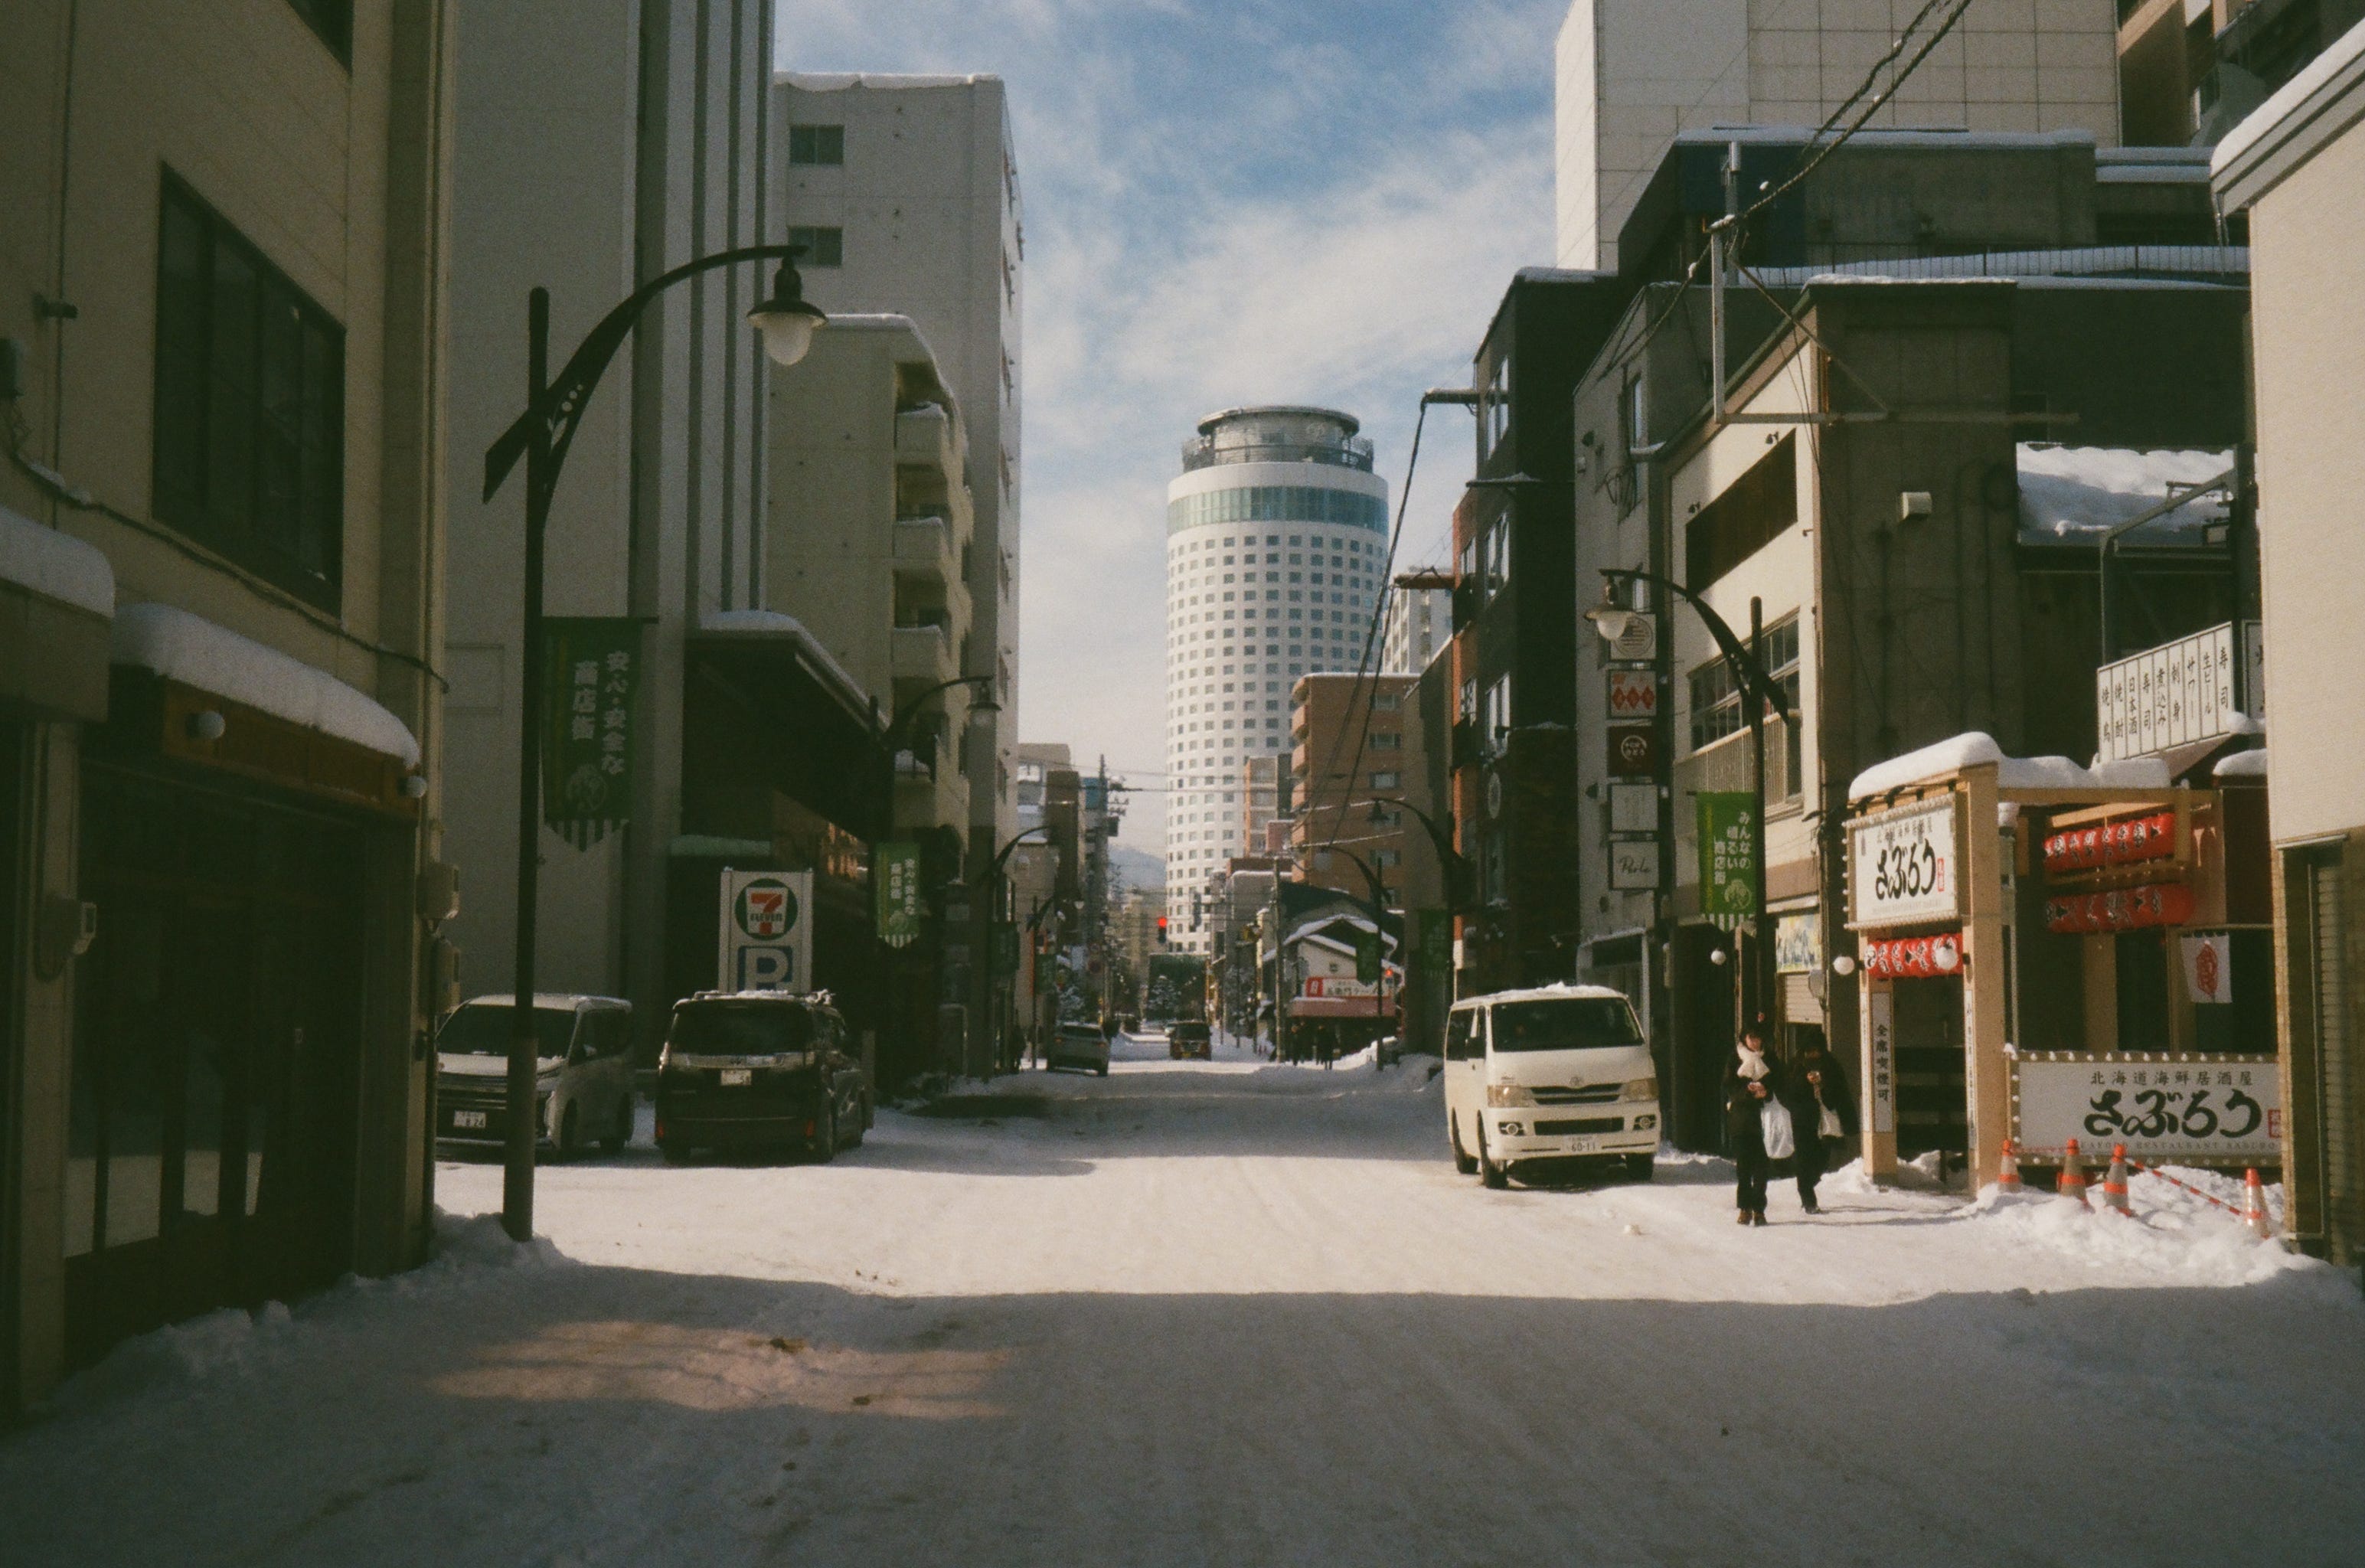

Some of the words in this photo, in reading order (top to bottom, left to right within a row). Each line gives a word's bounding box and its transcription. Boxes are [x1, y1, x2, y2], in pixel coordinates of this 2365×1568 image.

[572, 661, 600, 740] 商店街
[2128, 677, 2138, 734] 日本酒
[2219, 645, 2229, 709] 寿司
[1739, 812, 1752, 871] みんなの
[1875, 838, 1937, 901] さぶろう
[750, 893, 783, 936] 7
[746, 948, 789, 991] P
[1876, 1024, 1890, 1102] 全席喫煙可
[2091, 1070, 2252, 1086] 北海道海鮮居酒屋
[2083, 1089, 2262, 1138] さぶろう
